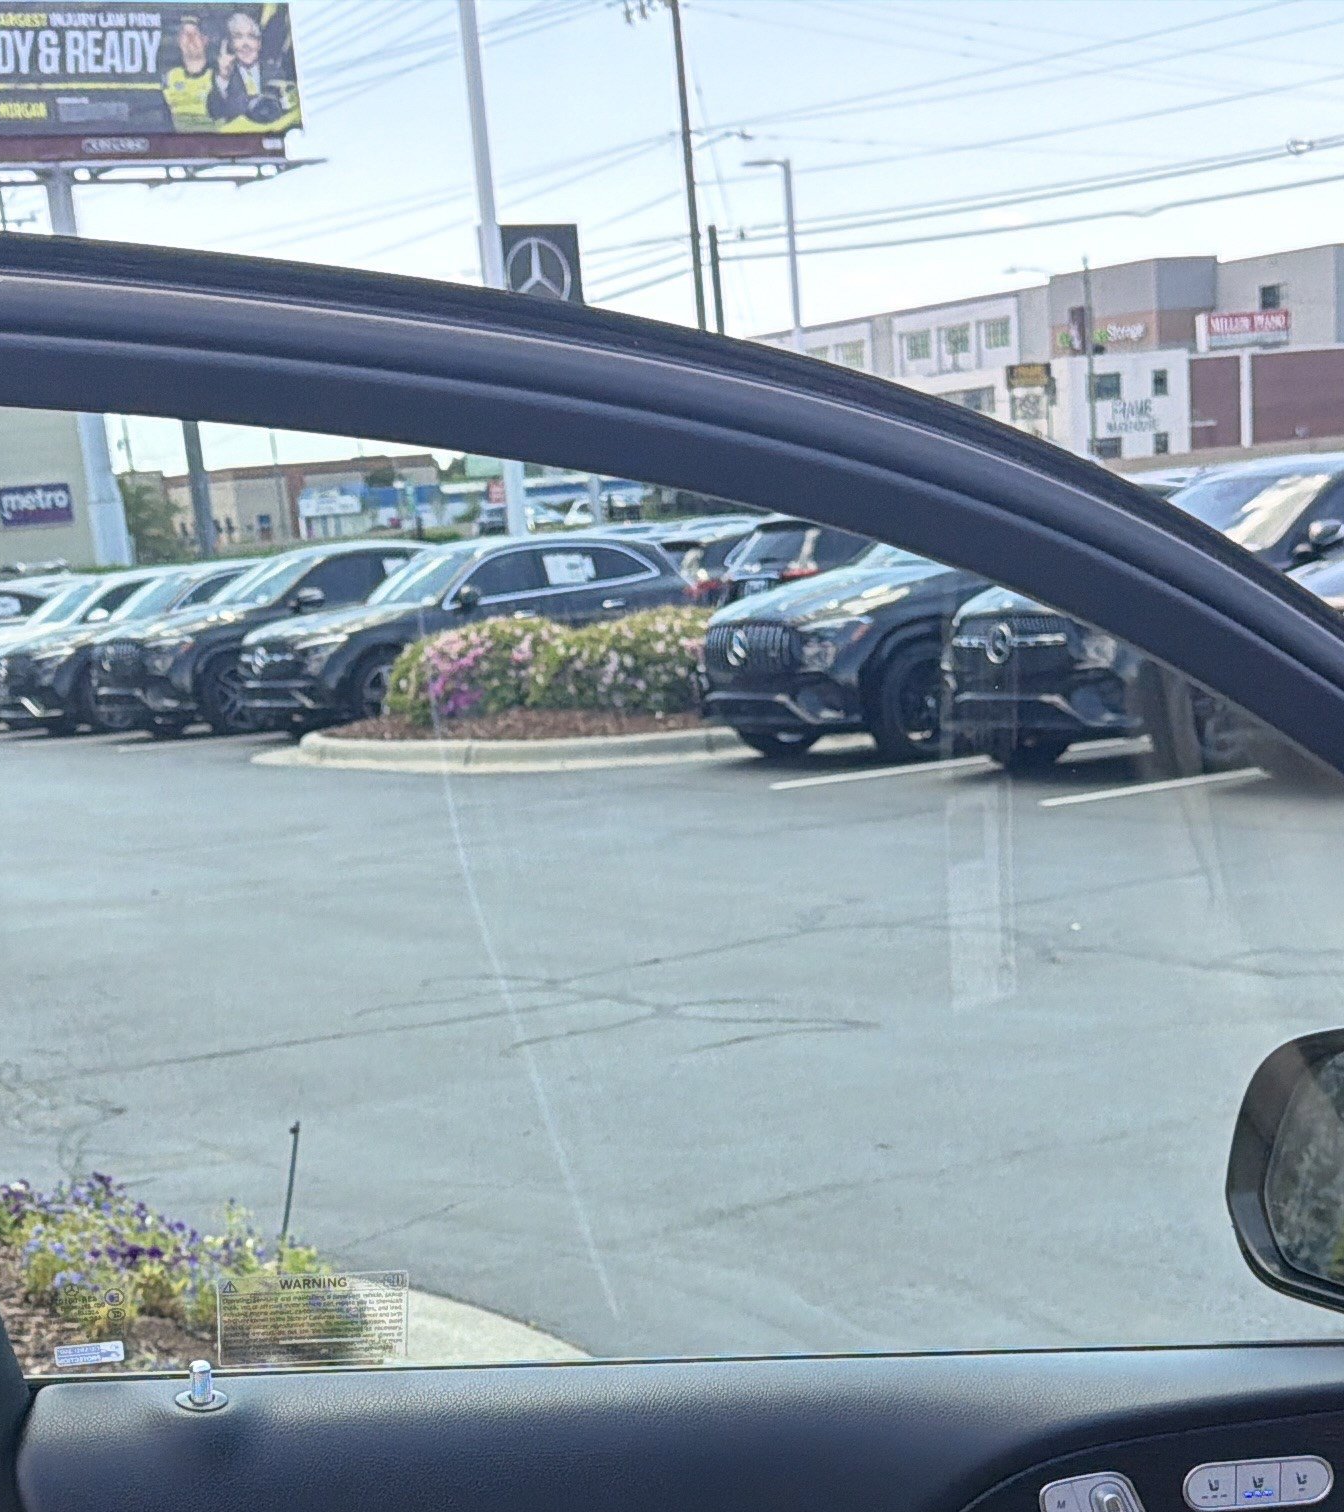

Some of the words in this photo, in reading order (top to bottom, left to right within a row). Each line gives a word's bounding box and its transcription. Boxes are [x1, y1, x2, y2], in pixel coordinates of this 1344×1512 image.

[37, 30, 60, 74] &
[65, 30, 162, 74] READY
[1, 488, 69, 520] metro
[279, 1276, 348, 1290] WARNING
